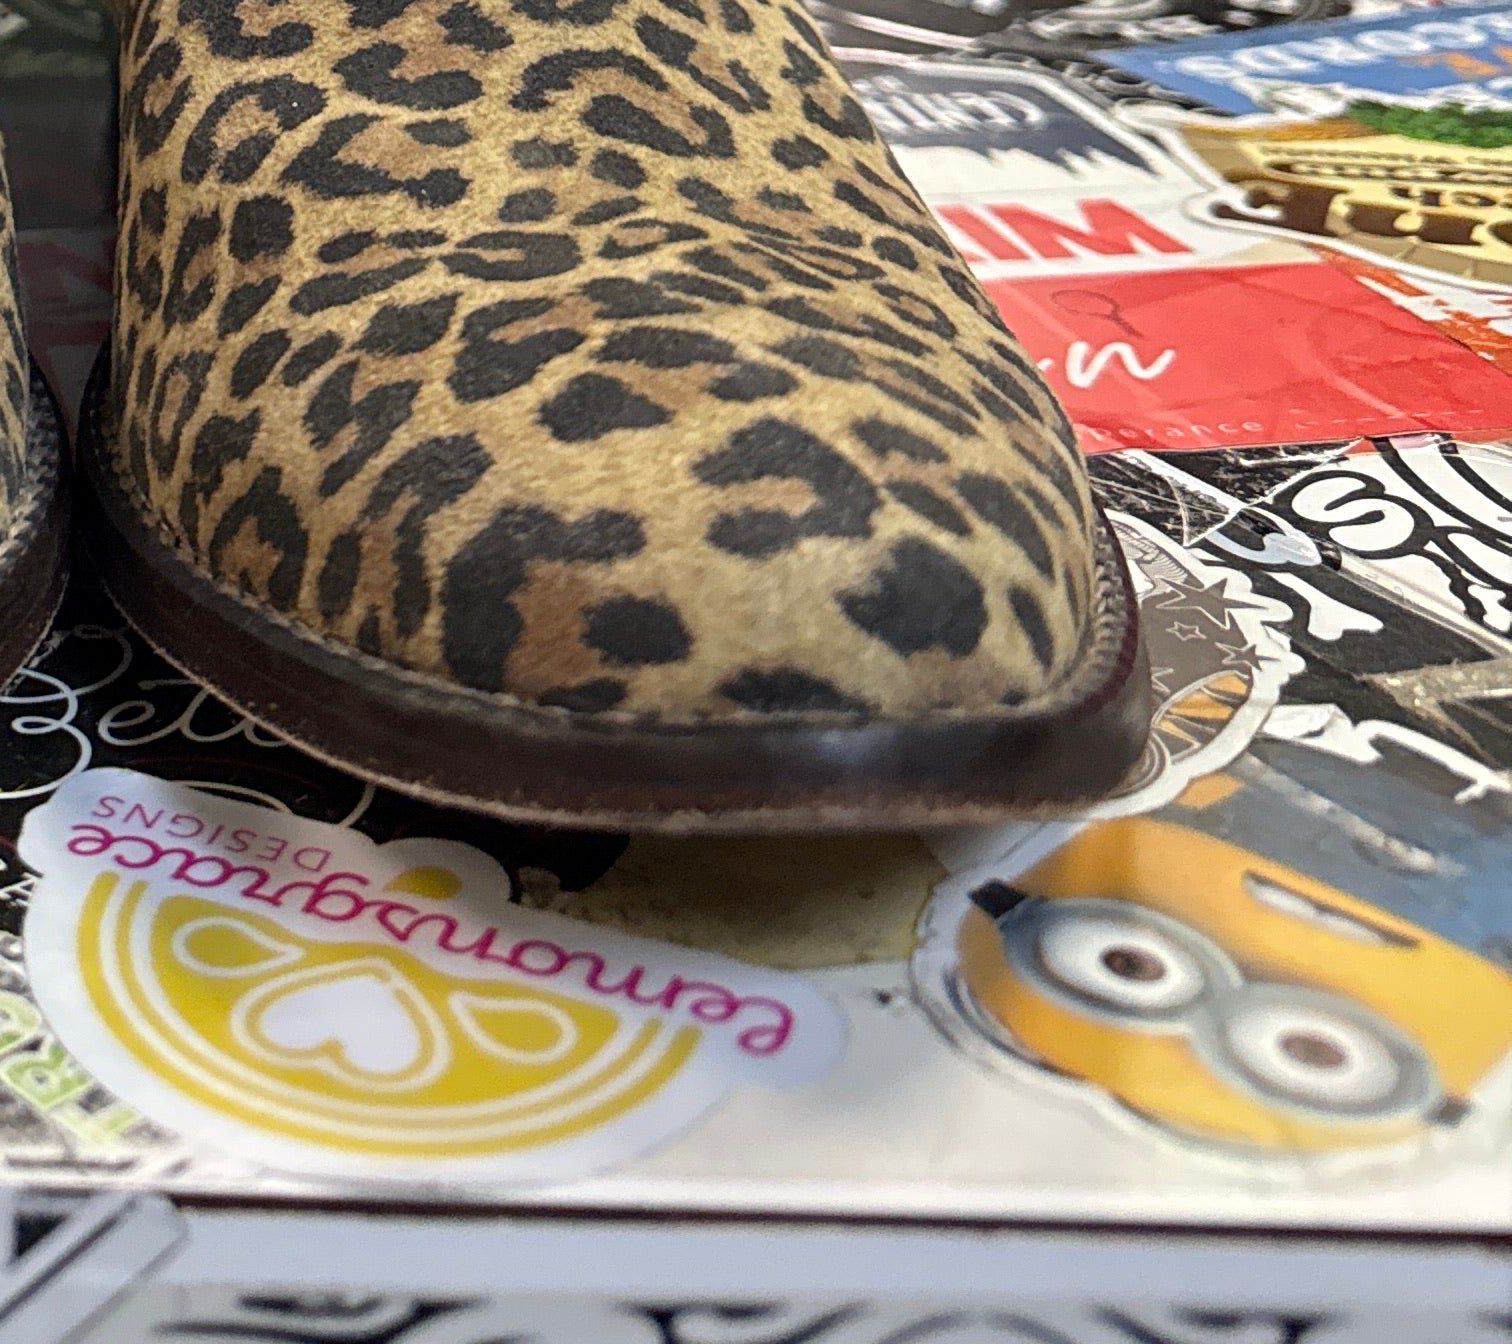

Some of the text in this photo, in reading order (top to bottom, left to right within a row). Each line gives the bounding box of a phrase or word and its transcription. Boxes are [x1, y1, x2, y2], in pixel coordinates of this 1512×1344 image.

[1085, 419, 1266, 442] perance
[89, 792, 329, 875] DESIGNS
[66, 822, 795, 1058] lemonsgrace
